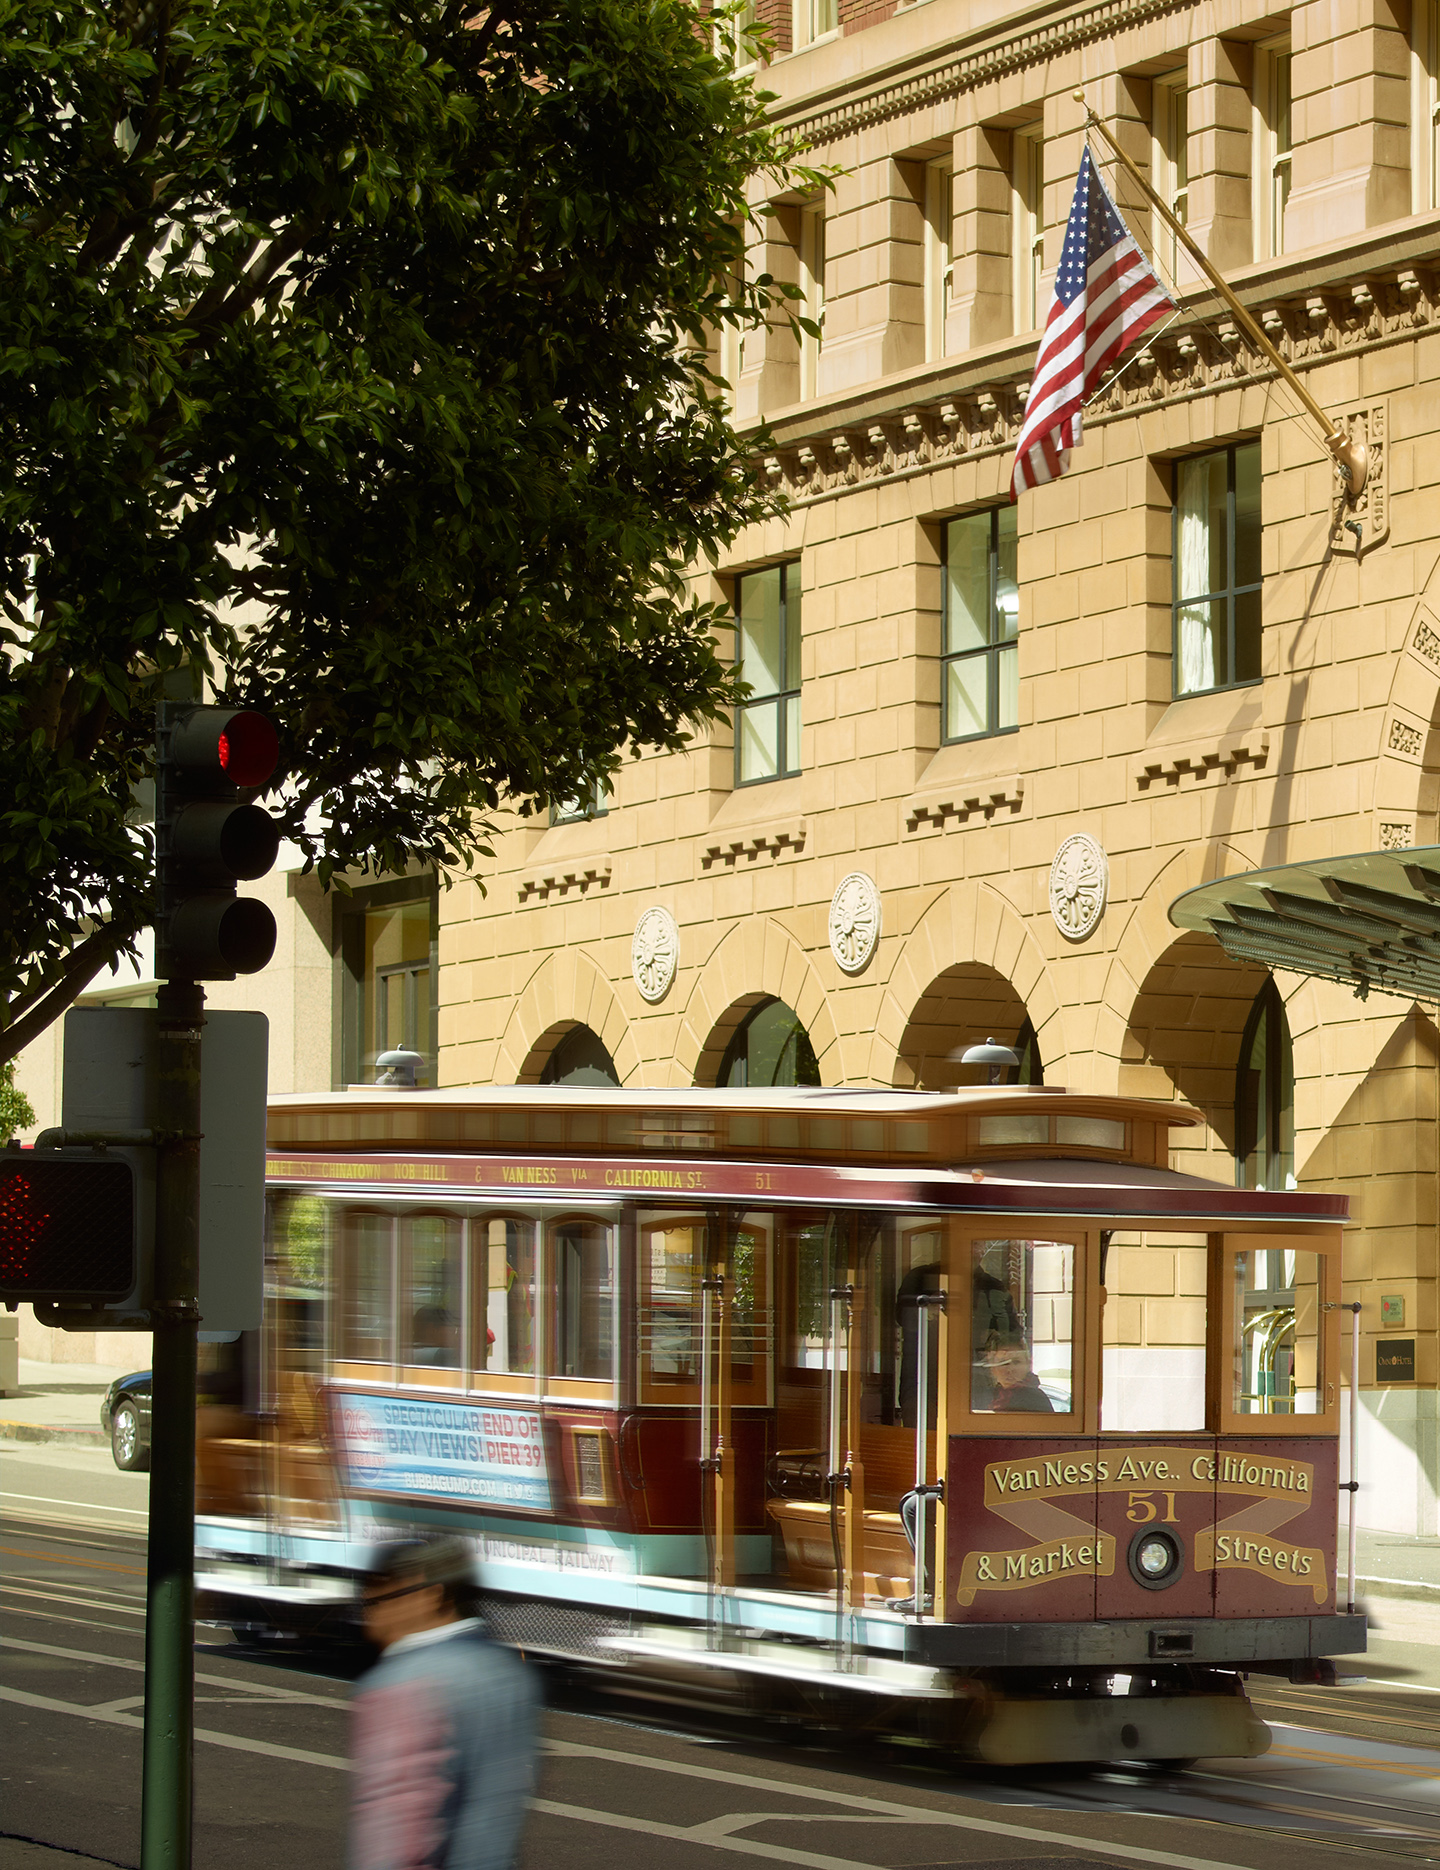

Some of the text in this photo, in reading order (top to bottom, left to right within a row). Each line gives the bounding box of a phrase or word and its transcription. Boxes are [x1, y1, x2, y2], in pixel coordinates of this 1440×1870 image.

[265, 1160, 293, 1176] RKET
[322, 1162, 381, 1180] CHINATOWN
[394, 1163, 415, 1180] NOB
[423, 1164, 448, 1181] HILL
[475, 1165, 482, 1183] &
[502, 1166, 524, 1184] VAN
[527, 1166, 557, 1185] NESS
[605, 1169, 683, 1188] CALIFORNIA
[755, 1172, 772, 1190] 51
[383, 1404, 538, 1439] SPECTACULAR END OF
[386, 1428, 541, 1467] BAY VIEWS! PIER 39
[404, 1471, 497, 1497] BUBBAGUMP.COM
[991, 1467, 1041, 1493] Van
[1043, 1460, 1109, 1487] Ness
[1191, 1455, 1309, 1493] California
[1126, 1491, 1180, 1523] 51
[475, 1537, 547, 1563] MUNICIPAL
[554, 1548, 615, 1573] RAILWAY
[977, 1537, 1313, 1581] & Market Streets
